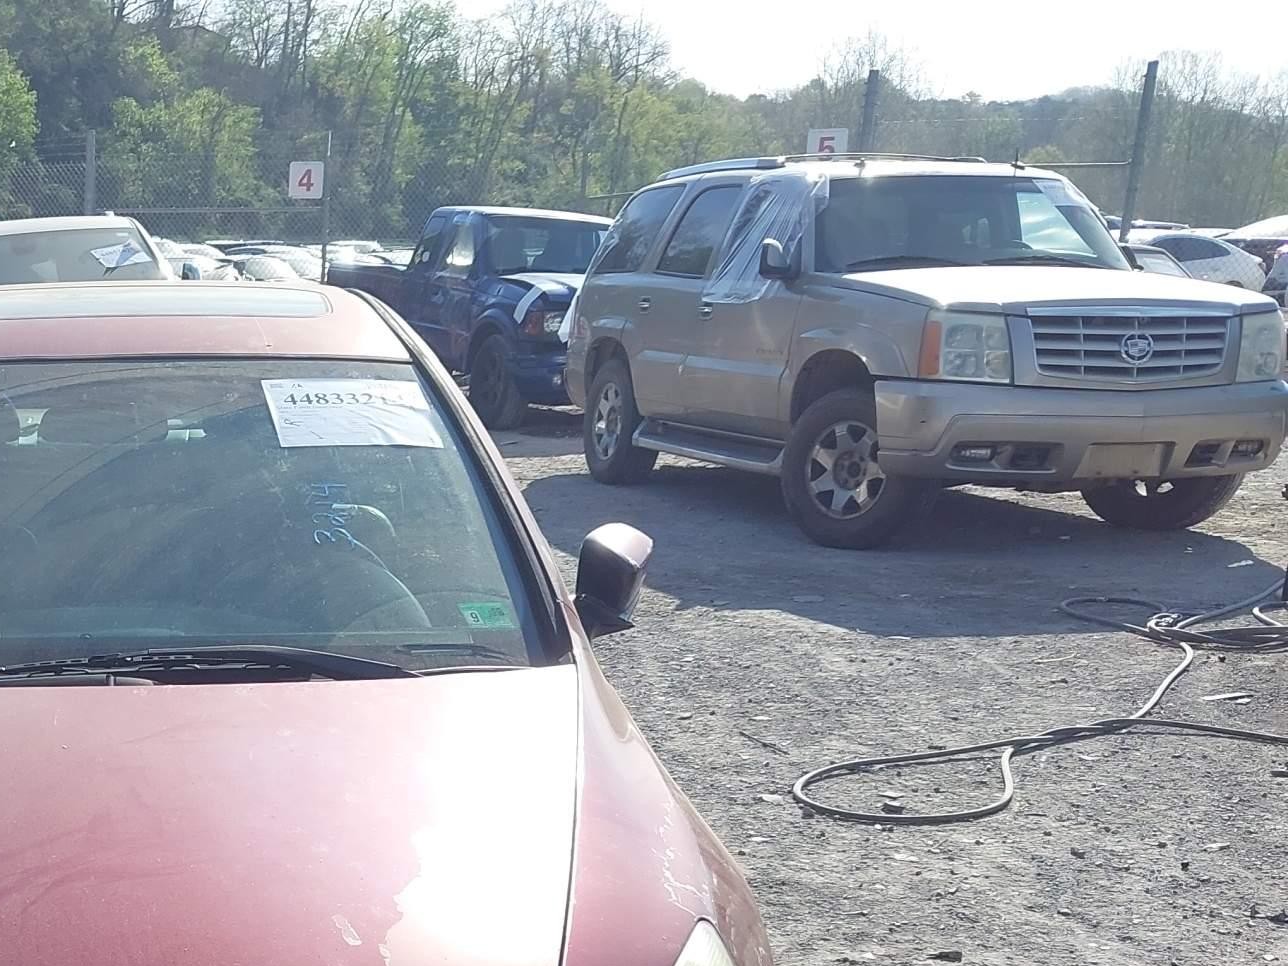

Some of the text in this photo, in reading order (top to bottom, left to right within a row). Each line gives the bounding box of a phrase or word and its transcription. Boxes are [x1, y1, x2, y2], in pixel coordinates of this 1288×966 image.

[817, 136, 836, 161] 5
[297, 168, 315, 192] 4
[283, 392, 404, 406] 448332
